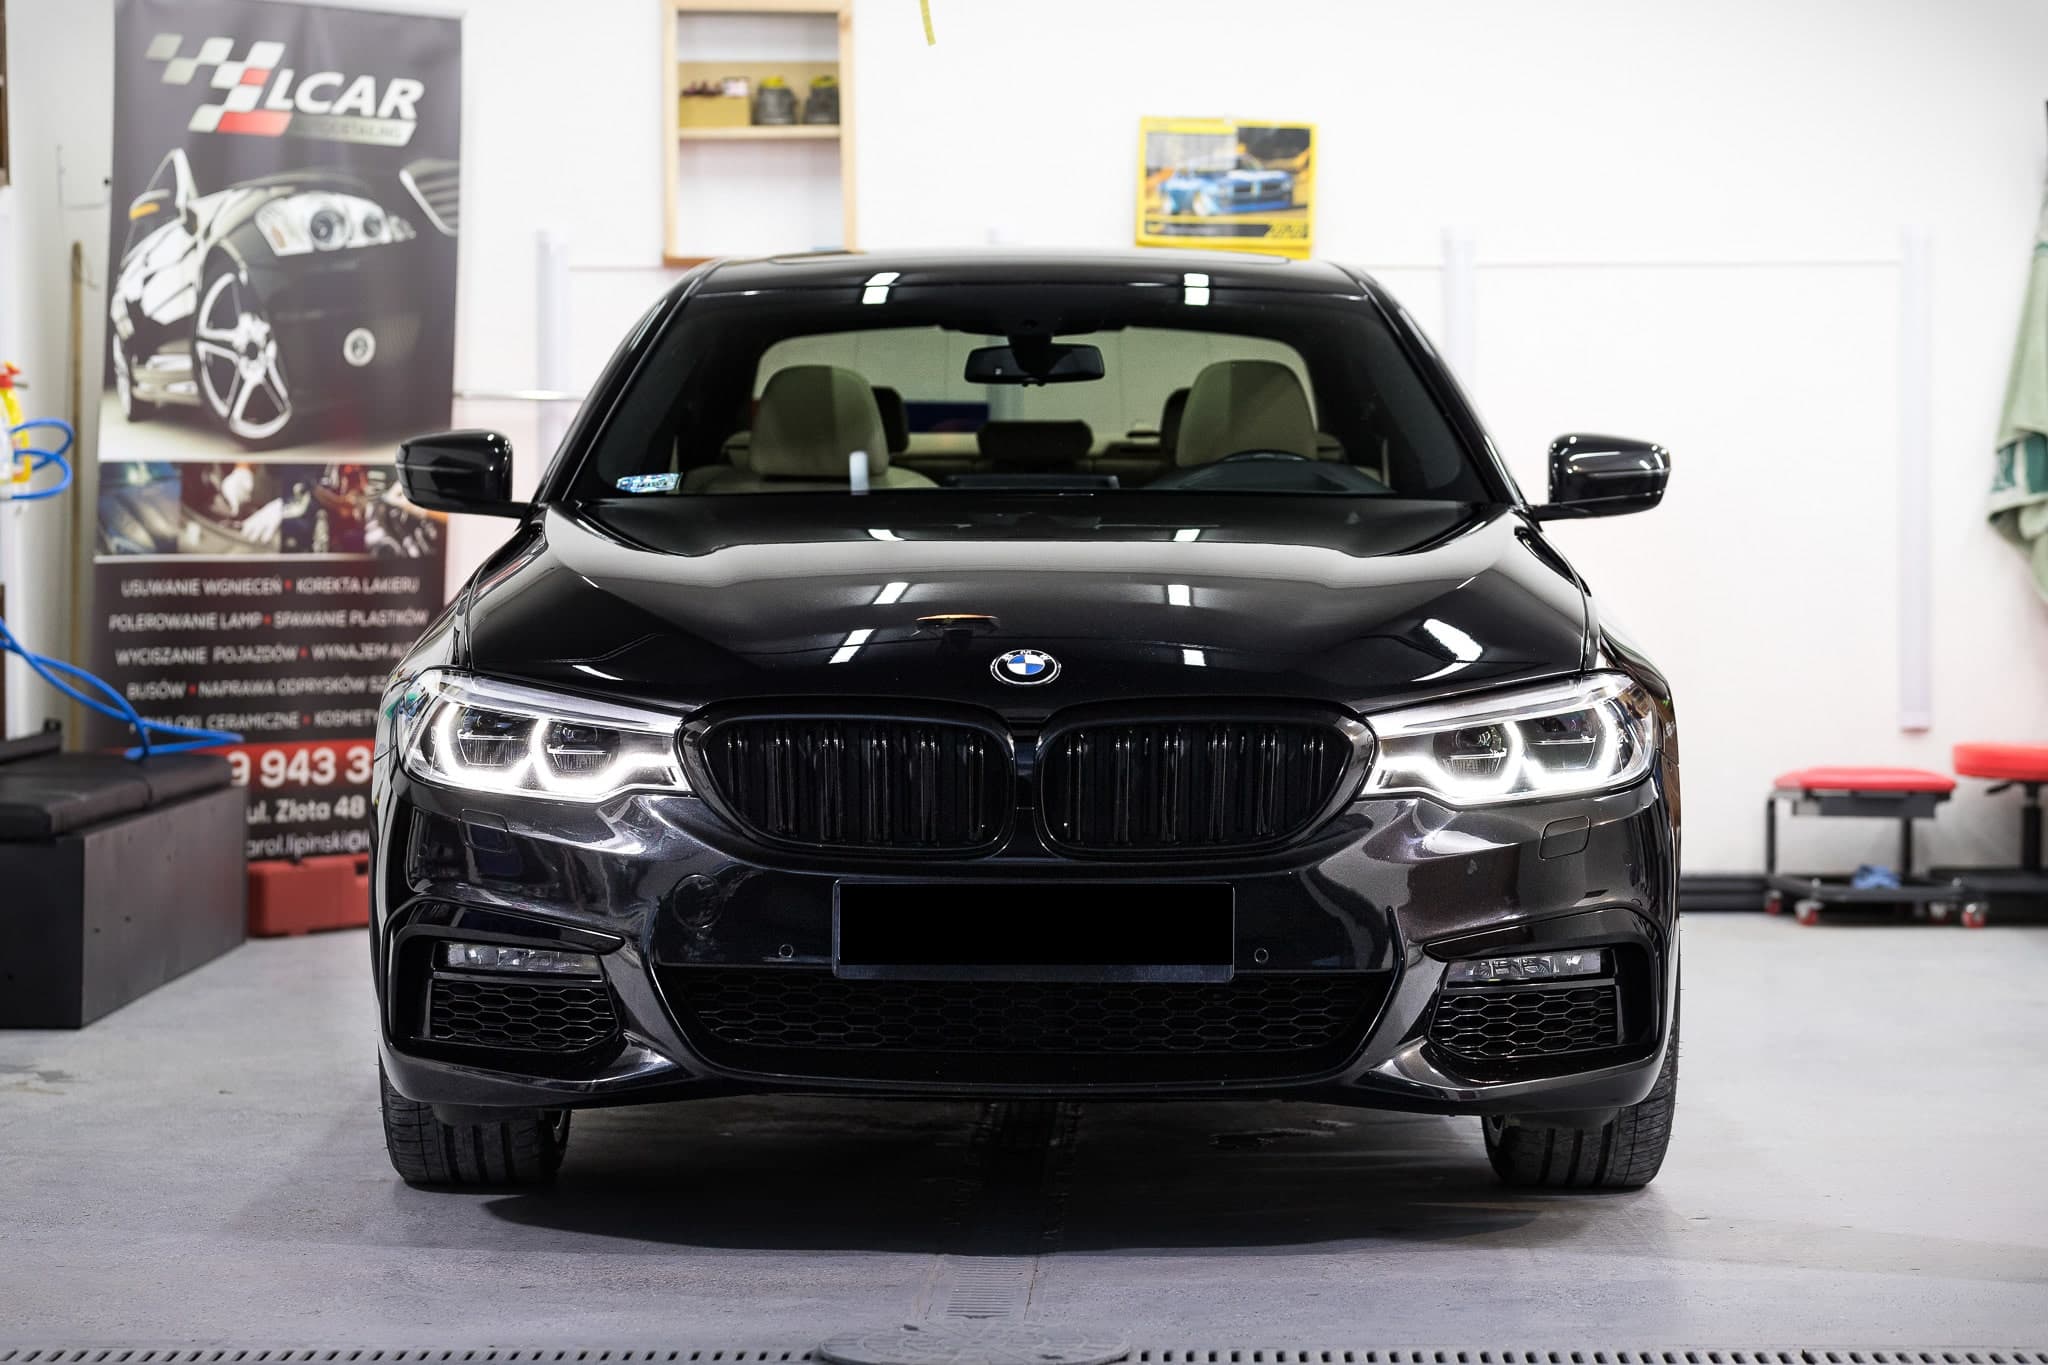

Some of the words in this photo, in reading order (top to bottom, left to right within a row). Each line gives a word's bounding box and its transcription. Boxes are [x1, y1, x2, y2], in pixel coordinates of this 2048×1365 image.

[265, 69, 424, 119] LCAR
[121, 577, 200, 597] USUWANIE
[202, 573, 282, 595] WGNIECEŃ
[295, 575, 360, 594] KOREKTA
[362, 575, 420, 594] LAKIERU
[109, 612, 217, 632] POLEROWANIE
[219, 611, 263, 630] LAMP
[273, 611, 347, 628] SPAWANIE
[349, 605, 430, 627] PLASTIKÓW
[115, 645, 208, 665] WYCISZANIE
[212, 642, 297, 664] POJAZDÓW
[312, 642, 388, 660] WYNAJEM
[126, 677, 186, 700] BUSÓW
[197, 680, 274, 697] NAPRAWA
[277, 674, 366, 695] ODPRYSKÓW
[205, 711, 299, 731] CERAMICZNE
[259, 746, 337, 788] 943
[247, 796, 270, 824] ul.
[275, 791, 329, 823] Złota
[334, 790, 366, 819] 48
